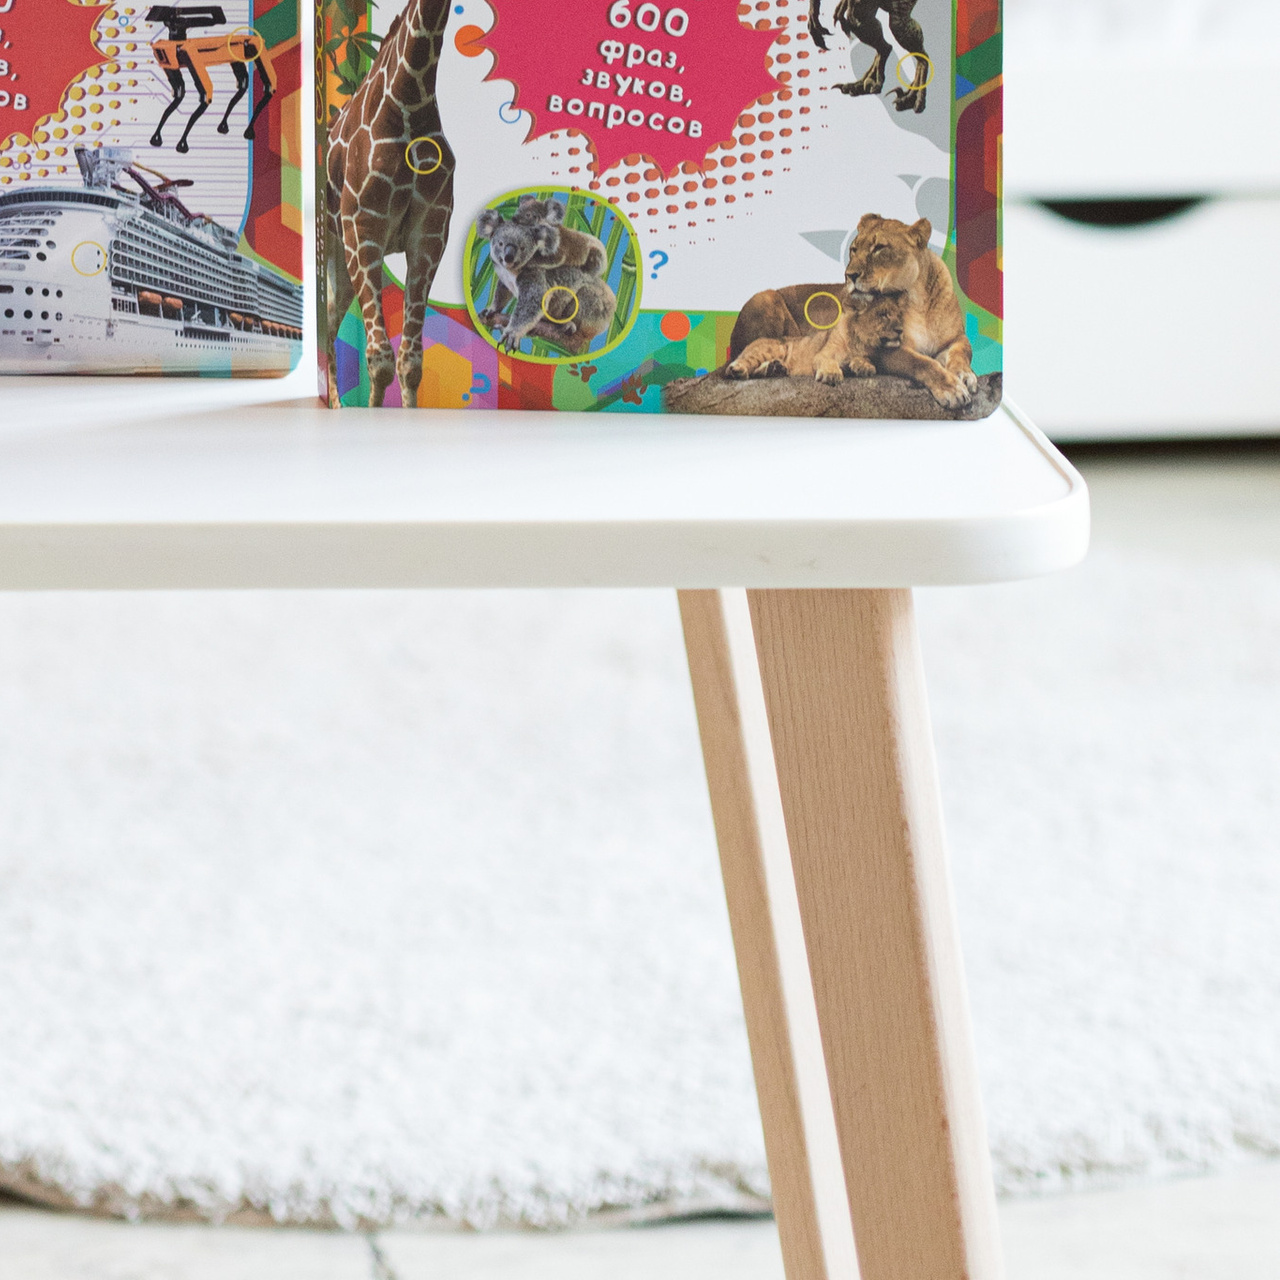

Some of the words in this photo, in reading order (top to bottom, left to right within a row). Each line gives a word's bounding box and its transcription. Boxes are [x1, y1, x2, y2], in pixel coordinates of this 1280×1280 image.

[598, 39, 685, 74] фраз,
[579, 68, 692, 108] звуков,
[547, 94, 703, 139] вопросов
